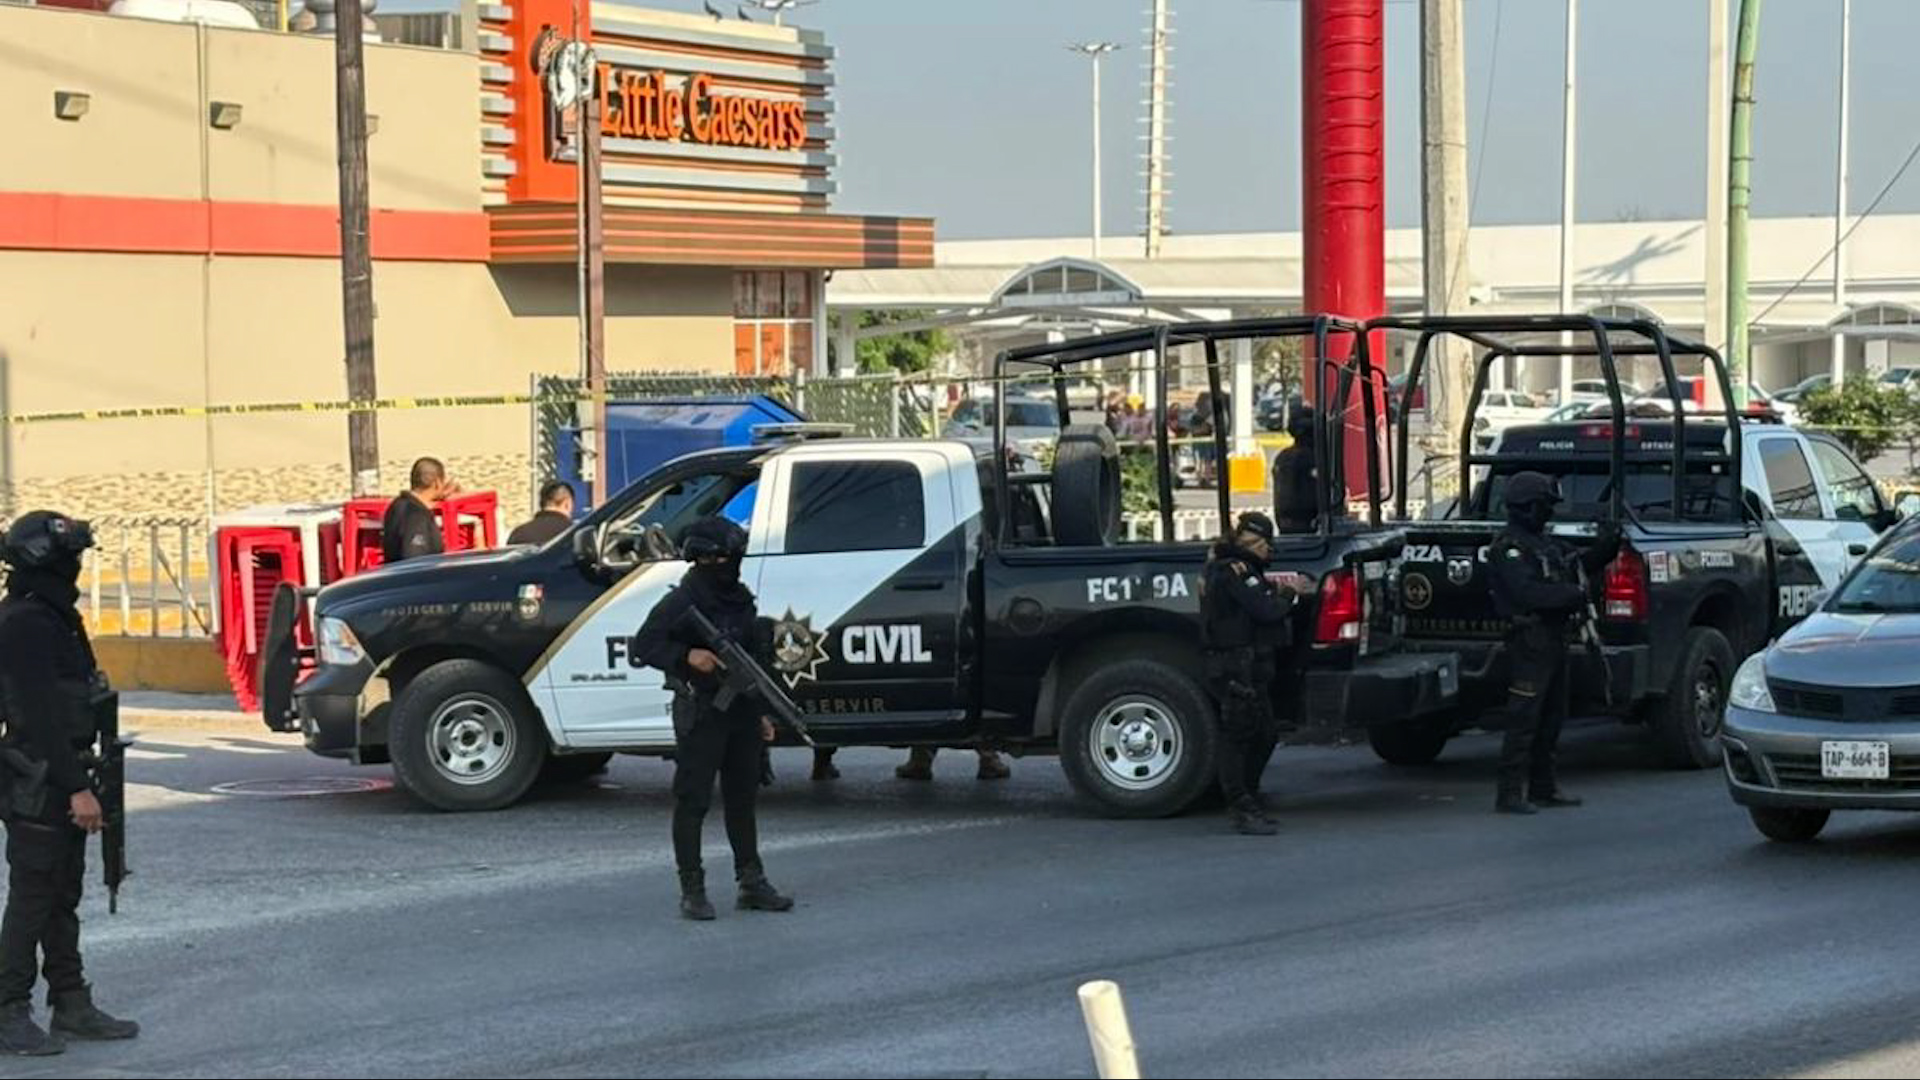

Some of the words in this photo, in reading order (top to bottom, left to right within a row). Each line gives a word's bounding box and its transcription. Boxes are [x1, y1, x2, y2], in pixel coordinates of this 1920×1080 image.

[598, 63, 683, 139] Little
[689, 74, 807, 149] Caesars
[1087, 572, 1189, 602] FC19A
[470, 601, 513, 612] SERVIR
[842, 624, 933, 664] CIVIL
[805, 698, 885, 713] SERVIR
[1824, 751, 1886, 768] TAP-664-B
